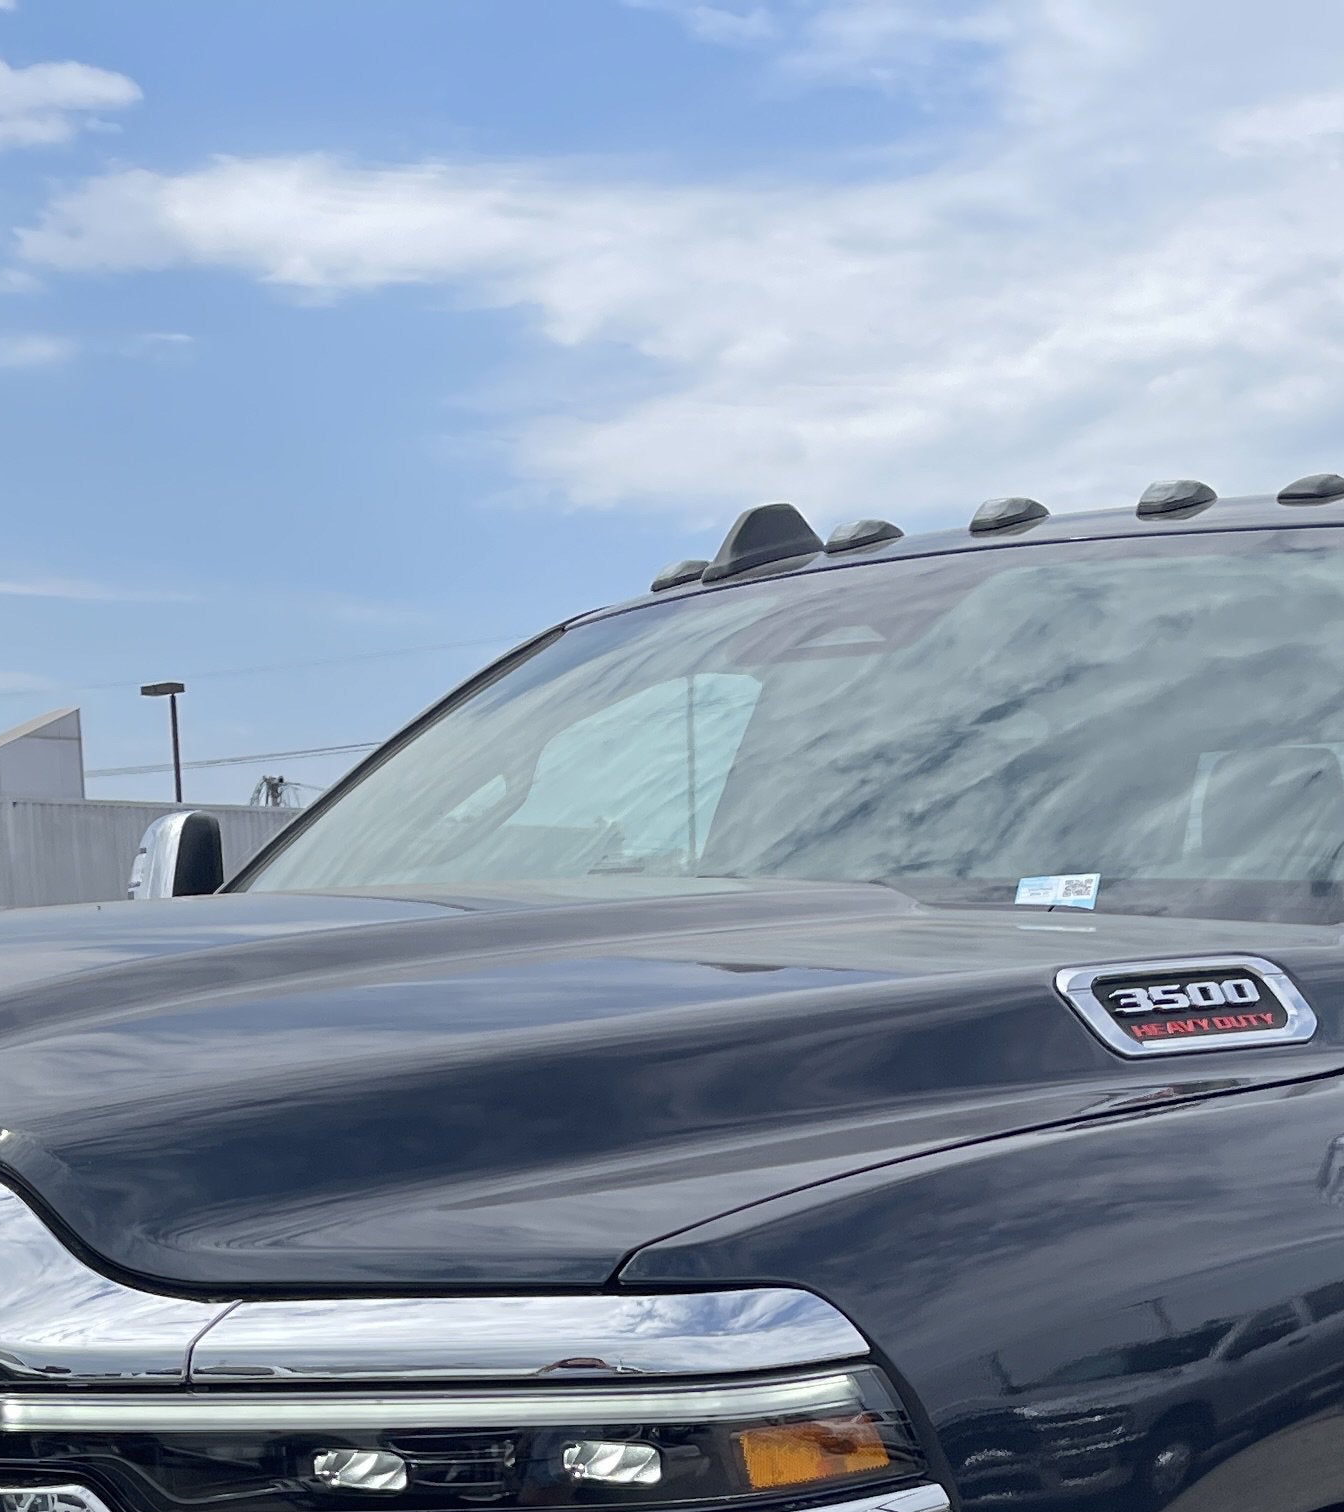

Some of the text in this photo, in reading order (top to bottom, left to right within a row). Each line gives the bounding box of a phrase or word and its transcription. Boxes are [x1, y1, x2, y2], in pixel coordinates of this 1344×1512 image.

[1109, 978, 1261, 1016] 3500
[1131, 1012, 1274, 1038] HEAVY DUTY
